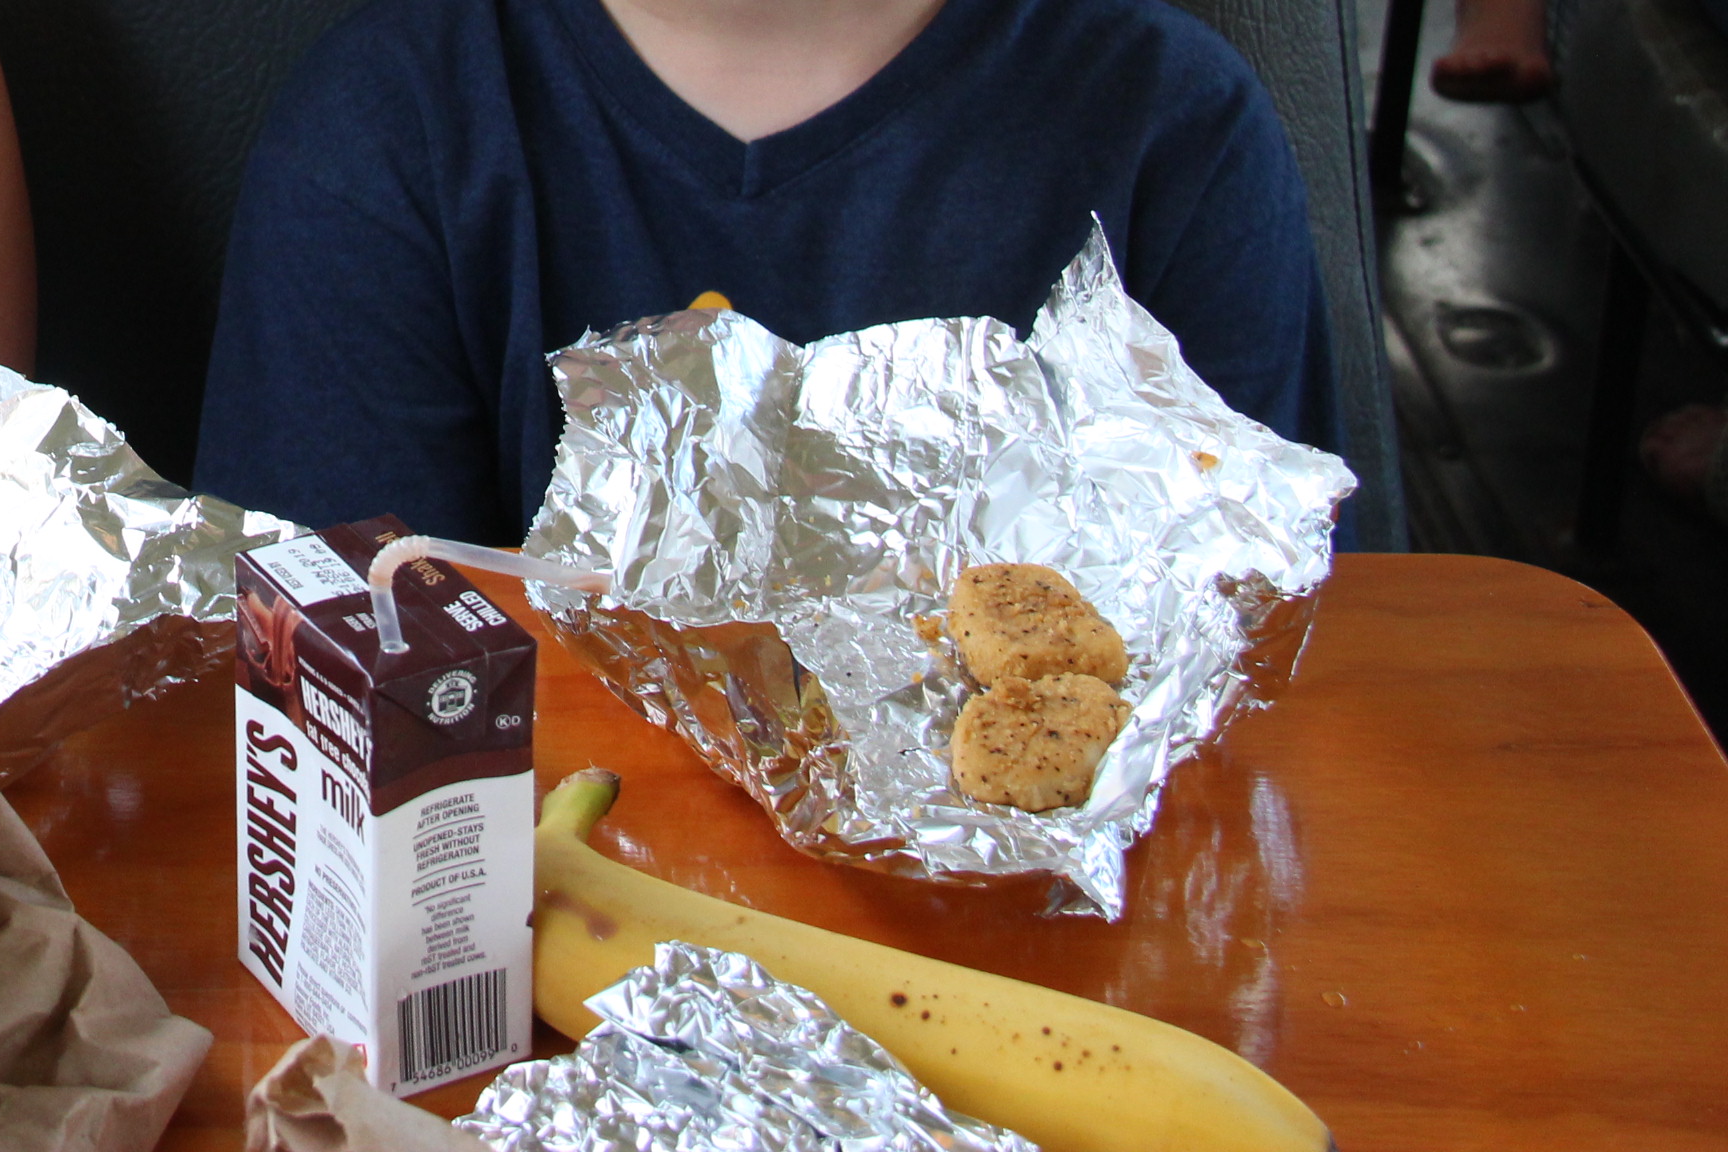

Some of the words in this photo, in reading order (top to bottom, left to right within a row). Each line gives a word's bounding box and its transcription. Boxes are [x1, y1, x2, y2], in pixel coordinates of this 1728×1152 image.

[411, 556, 445, 586] Shak
[443, 600, 484, 632] SERVE
[459, 590, 507, 626] CHILLED
[428, 670, 477, 694] DELIVERING
[428, 703, 475, 725] NUTRITION
[306, 720, 319, 744] fat
[320, 733, 340, 763] free
[321, 768, 365, 846] milk
[417, 813, 440, 830] AFTER
[442, 804, 480, 820] OPENING
[421, 793, 475, 817] REFRIGERATE
[413, 823, 484, 852] UNOPENED-STAYS
[416, 845, 440, 862] FRESH
[442, 834, 480, 850] WITHOUT
[246, 719, 298, 989] HERSHEY'S
[417, 845, 480, 872] REFRIGERATION
[411, 877, 446, 898] PRODUCT
[448, 874, 459, 884] OF
[462, 868, 487, 880] U.S.A.
[437, 893, 471, 909] significant
[431, 907, 464, 922] difference
[434, 921, 450, 931] been
[452, 914, 475, 925] shown
[426, 930, 453, 944] between
[427, 939, 452, 954] derived
[453, 935, 469, 945] from
[438, 946, 462, 960] treated
[463, 942, 475, 953] and
[442, 955, 466, 970] treated
[413, 1065, 451, 1084] 54686
[457, 1048, 495, 1070] 00099
[511, 1043, 518, 1053] 0
